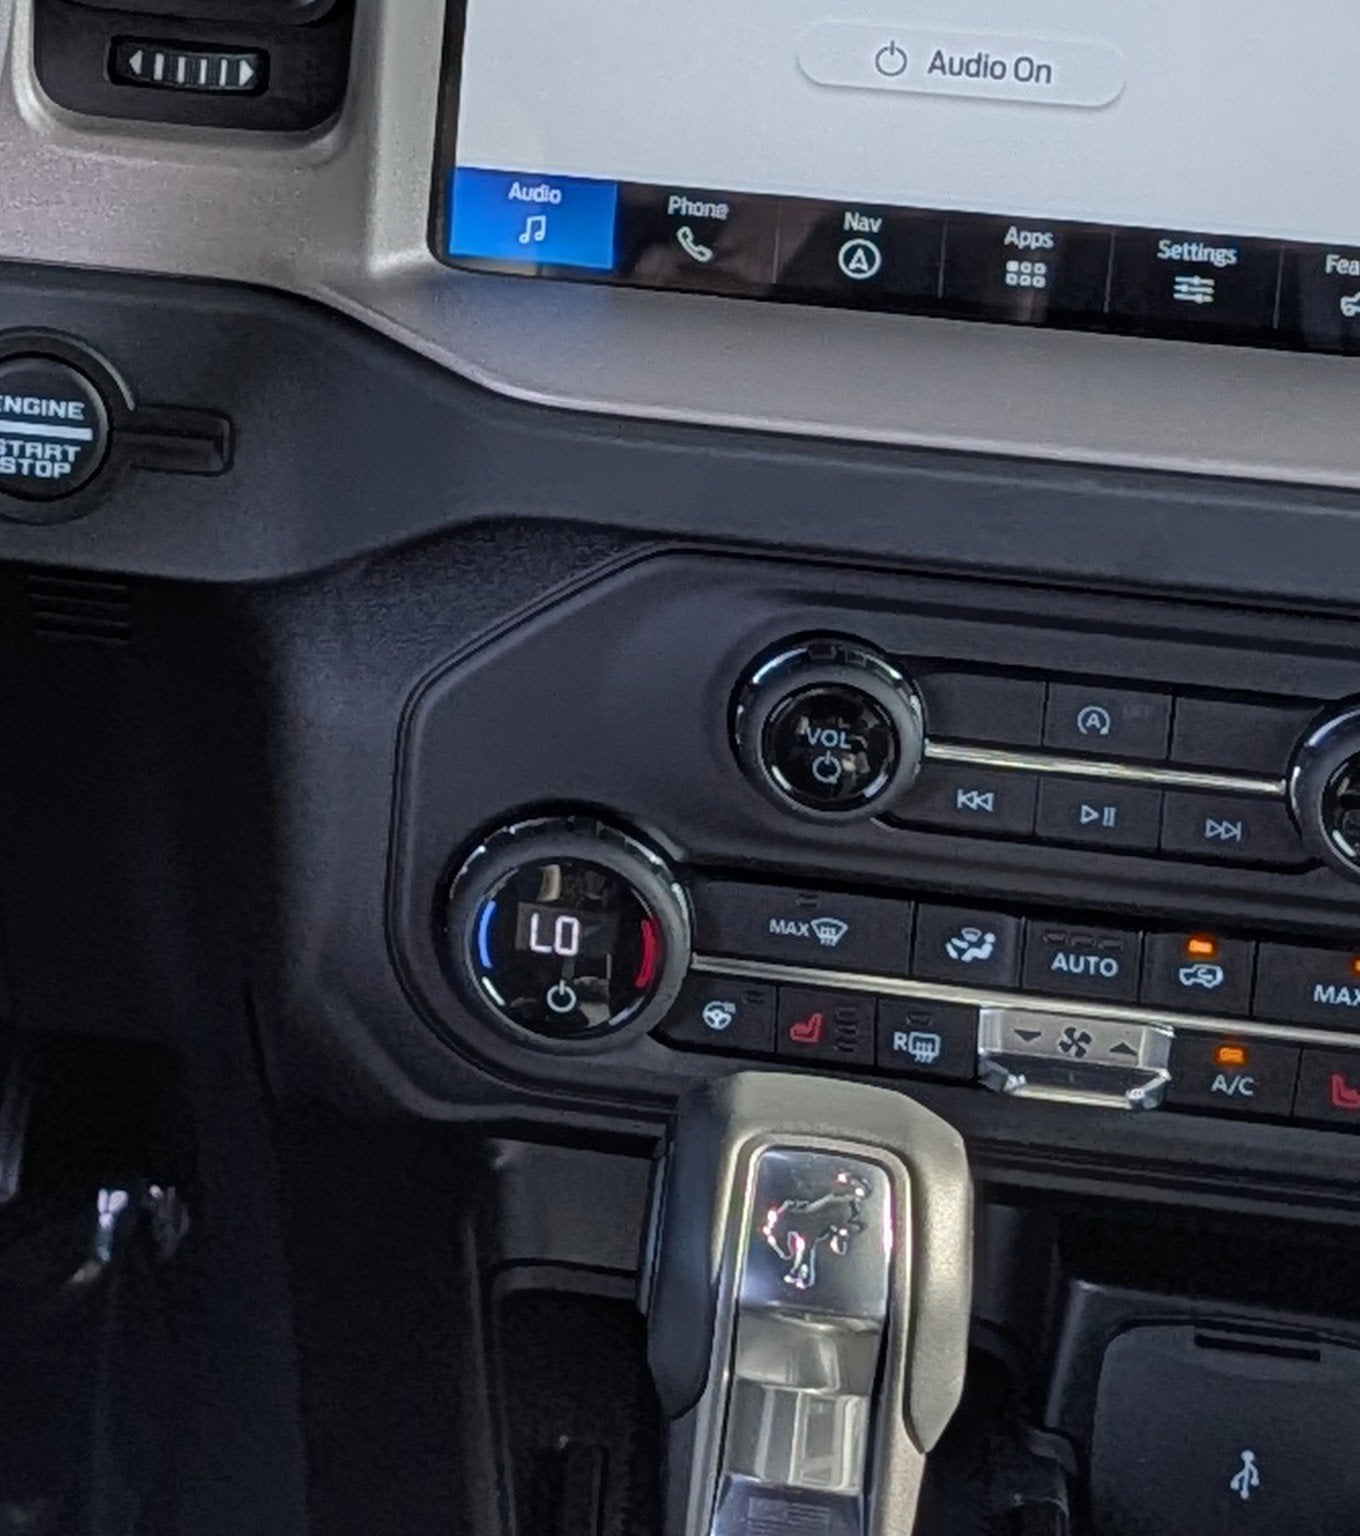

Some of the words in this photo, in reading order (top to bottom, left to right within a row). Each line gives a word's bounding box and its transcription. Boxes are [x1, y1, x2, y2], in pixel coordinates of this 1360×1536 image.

[927, 51, 1009, 82] Audio
[1014, 56, 1053, 85] On
[508, 181, 562, 205] Audio
[667, 195, 730, 220] Phone
[844, 211, 882, 234] Nav
[1004, 225, 1054, 252] Apps
[1157, 239, 1238, 267] Settings
[806, 727, 852, 750] VOL
[769, 918, 810, 937] MAX
[1051, 952, 1118, 977] AUTO
[1314, 984, 1360, 1007] MAX
[893, 1031, 908, 1051] R
[1211, 1074, 1256, 1096] A/C
